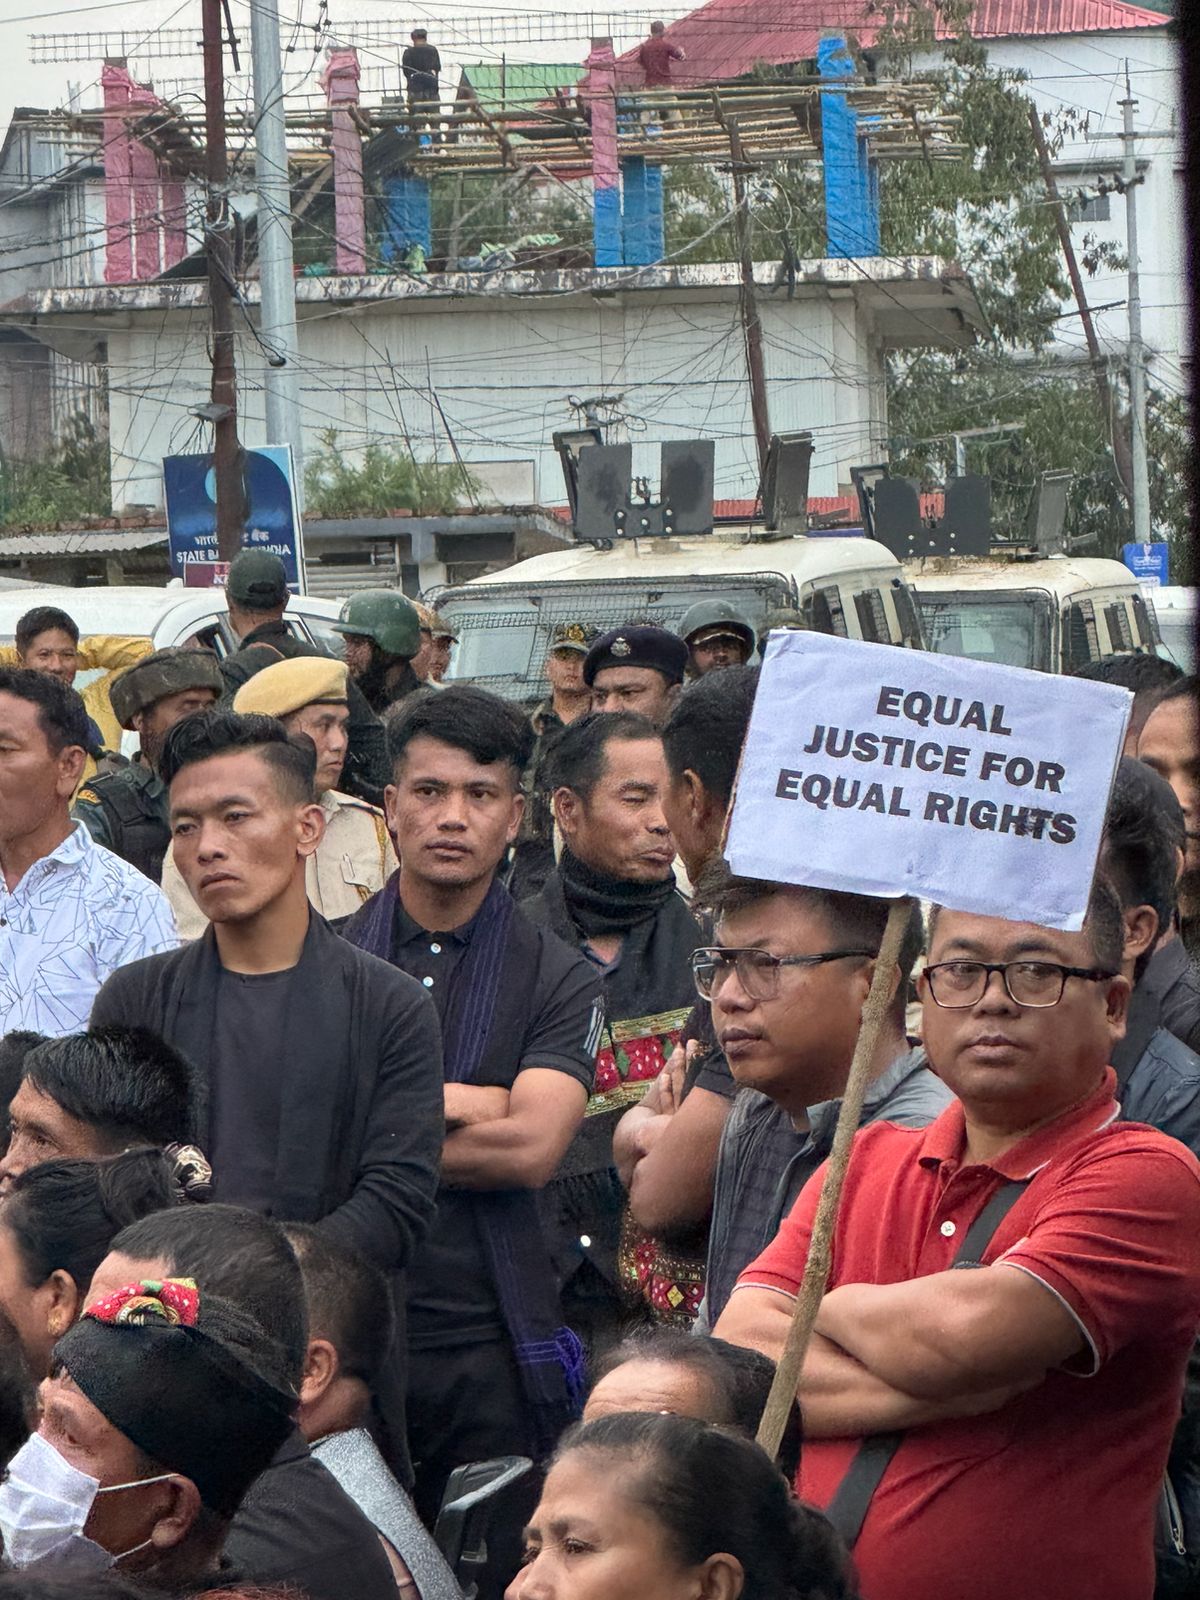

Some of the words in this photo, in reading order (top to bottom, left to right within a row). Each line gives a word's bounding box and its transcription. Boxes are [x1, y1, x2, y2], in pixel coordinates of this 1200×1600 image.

[176, 550, 205, 563] STATE
[876, 686, 1012, 737] EQUAL
[803, 724, 972, 777] JUSTICE
[979, 751, 1066, 794] FOR
[775, 768, 911, 817] EQUAL
[923, 791, 1077, 845] RIGHTS
